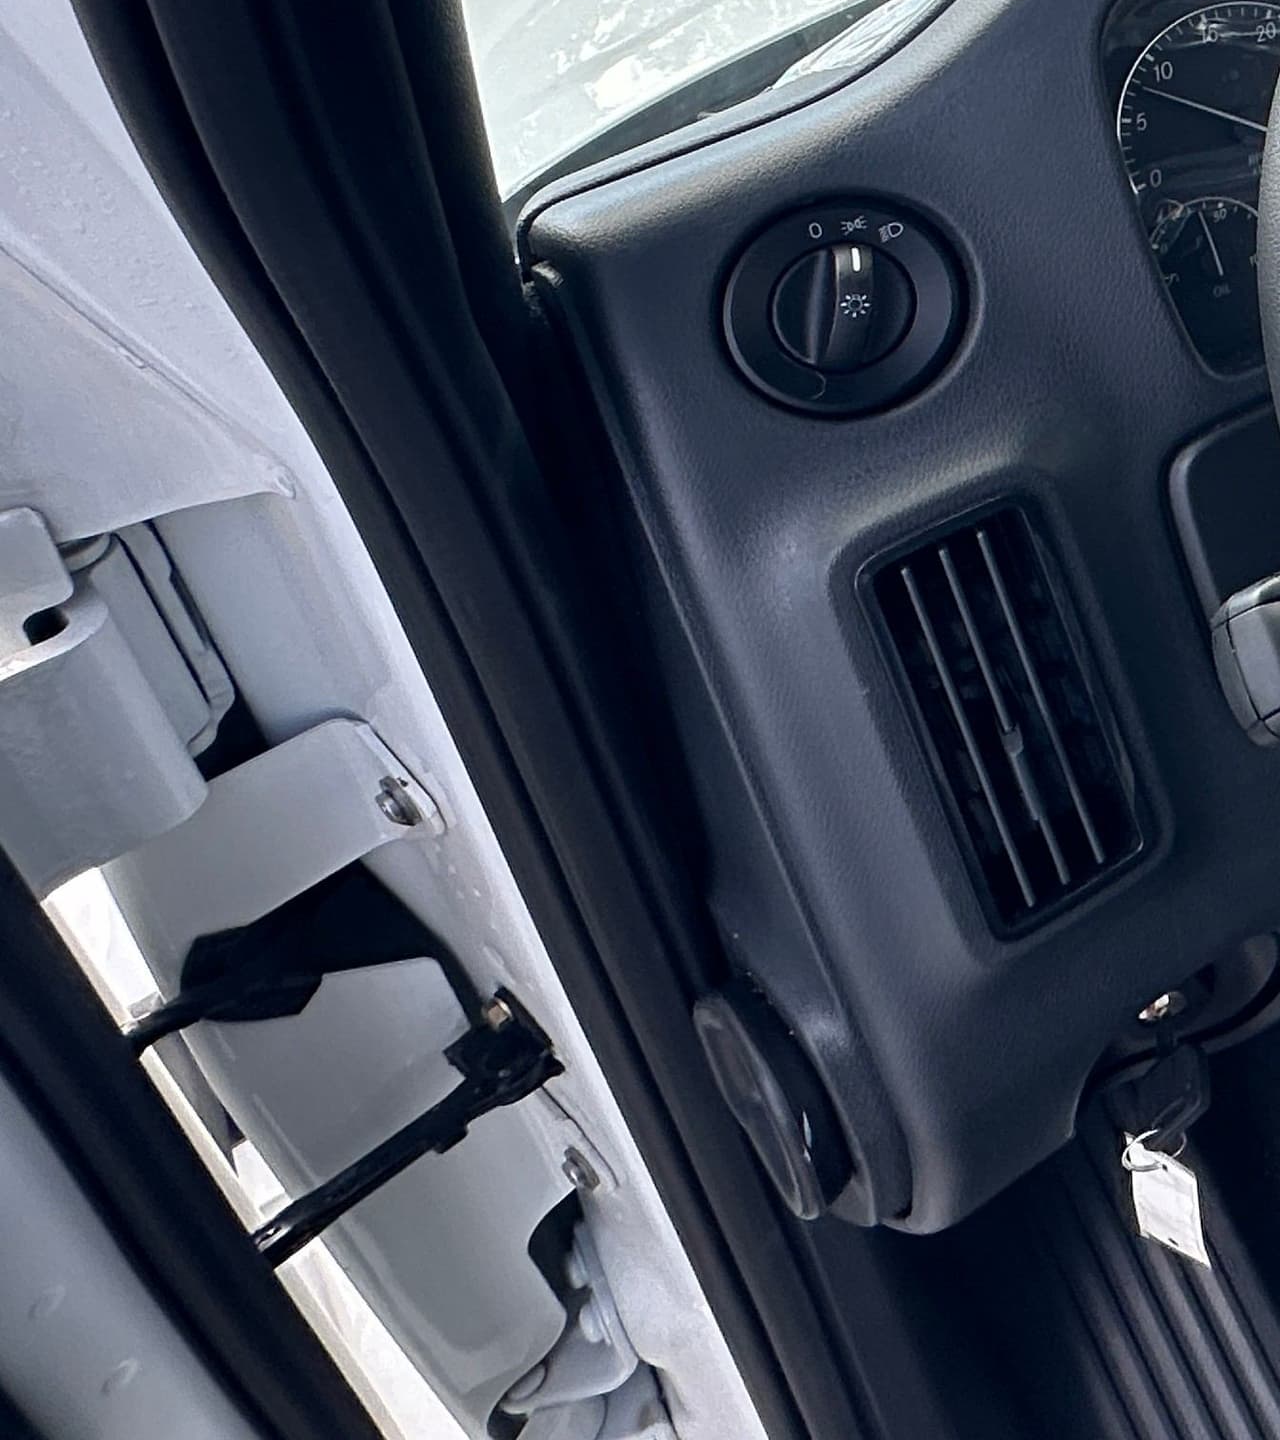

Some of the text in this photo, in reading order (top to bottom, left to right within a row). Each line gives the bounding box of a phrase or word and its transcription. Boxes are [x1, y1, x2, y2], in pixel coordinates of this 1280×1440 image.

[1256, 21, 1277, 44] 20
[1153, 61, 1174, 83] 10
[1136, 112, 1147, 132] 5
[1150, 169, 1162, 188] 0
